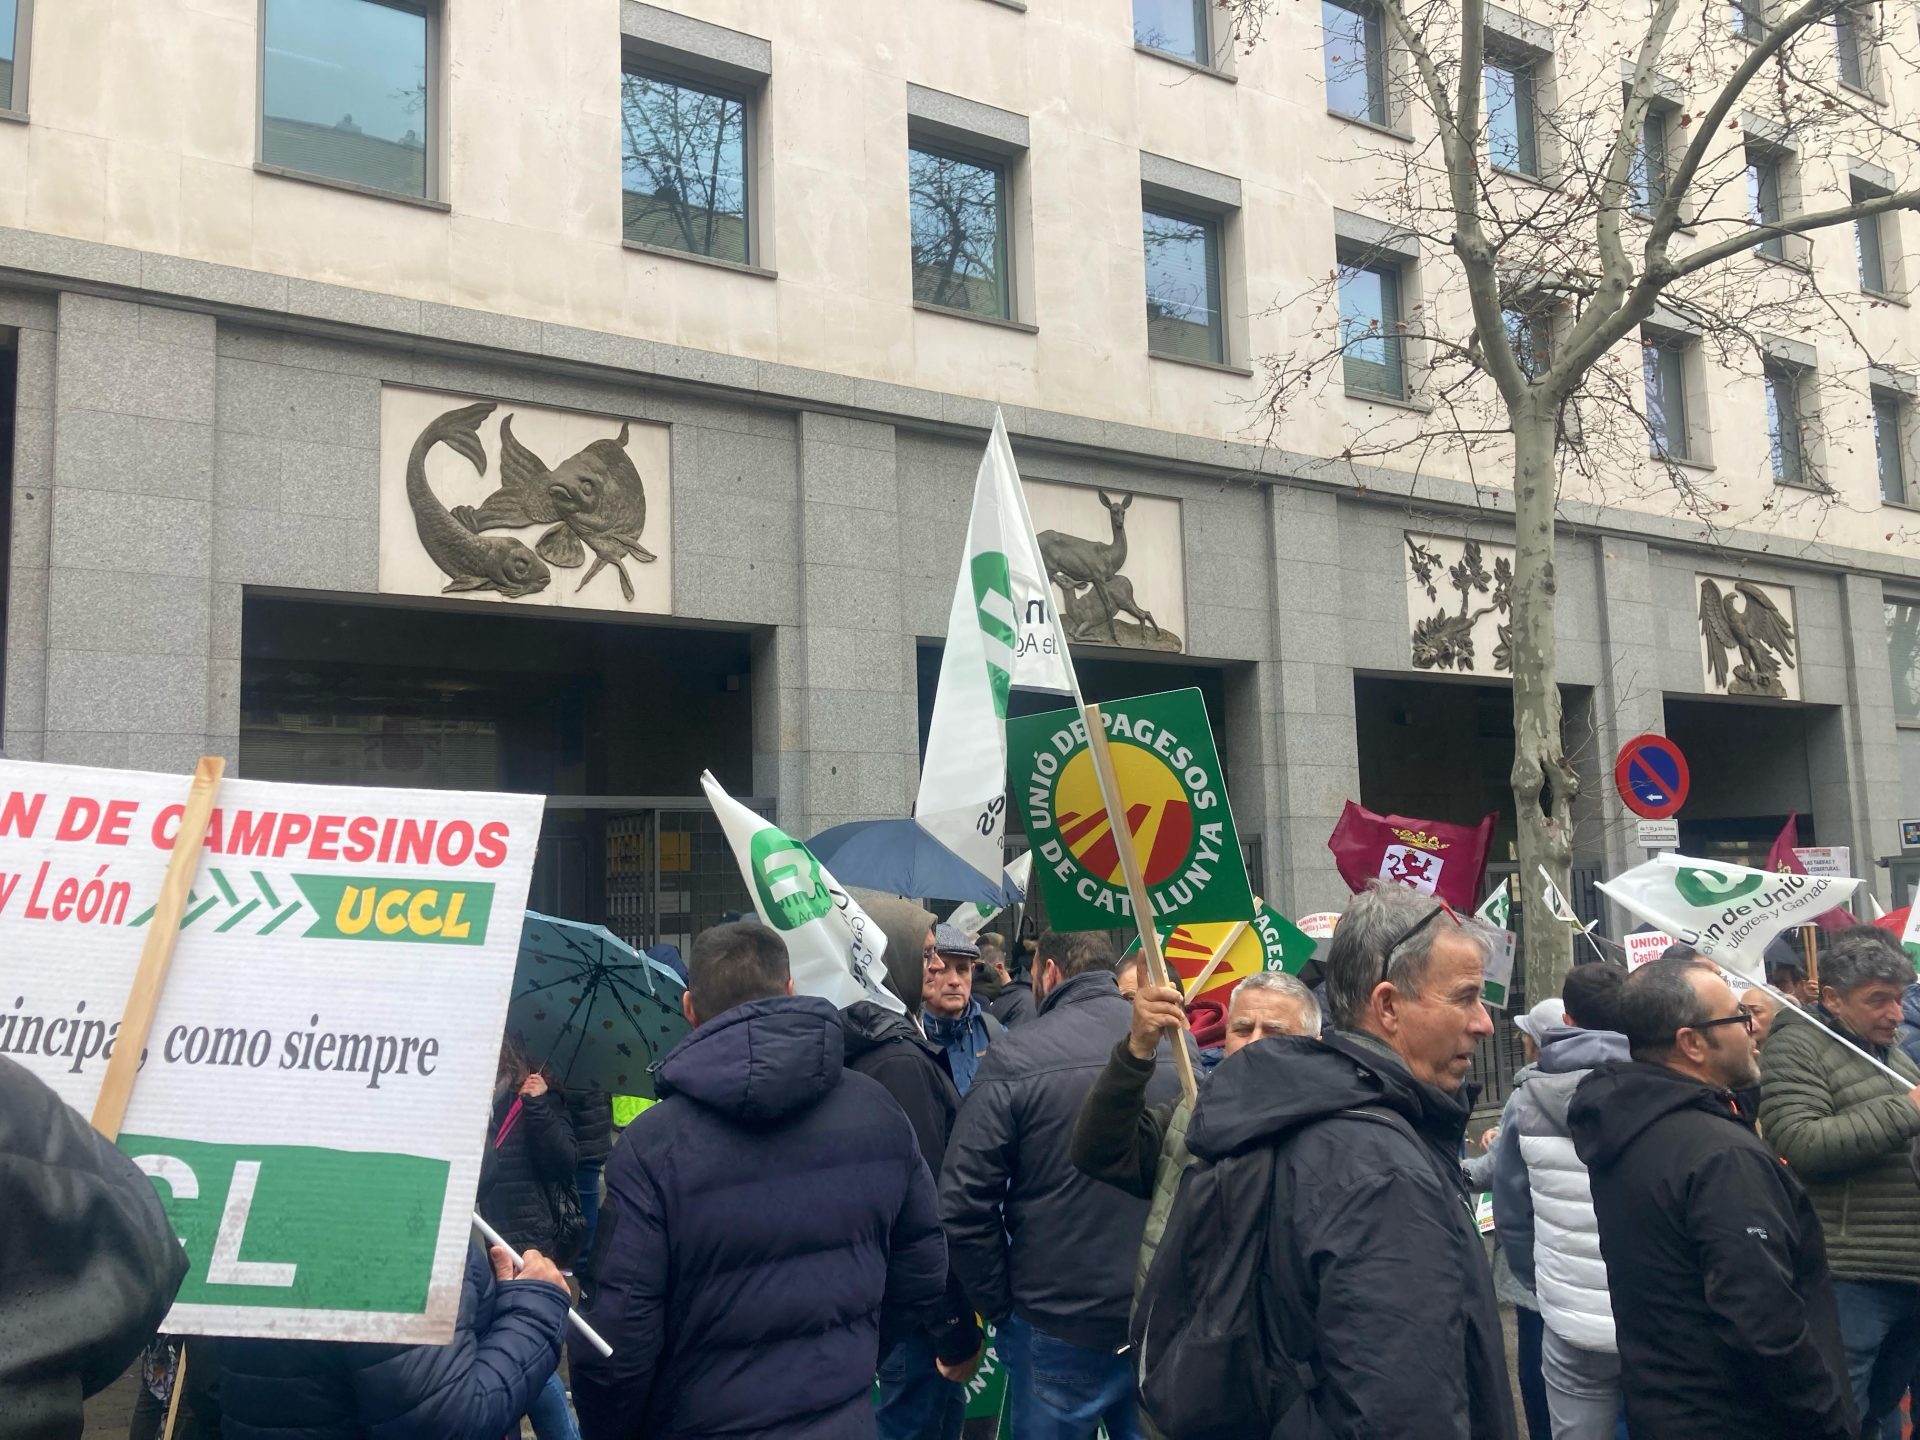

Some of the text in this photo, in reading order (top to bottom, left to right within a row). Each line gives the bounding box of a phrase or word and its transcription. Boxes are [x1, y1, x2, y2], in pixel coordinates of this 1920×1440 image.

[1030, 751, 1058, 829] UNIÓ
[1051, 718, 1089, 756] DE
[1099, 713, 1217, 810] PAGESOS
[0, 791, 510, 869] N DE CAMPESINOS
[1040, 839, 1078, 882] DE
[24, 861, 131, 925] León
[336, 886, 470, 938] UCCL
[1721, 904, 1753, 926] de
[1631, 936, 1668, 949] UNION
[163, 1019, 272, 1067] como
[278, 1014, 440, 1088] siempre
